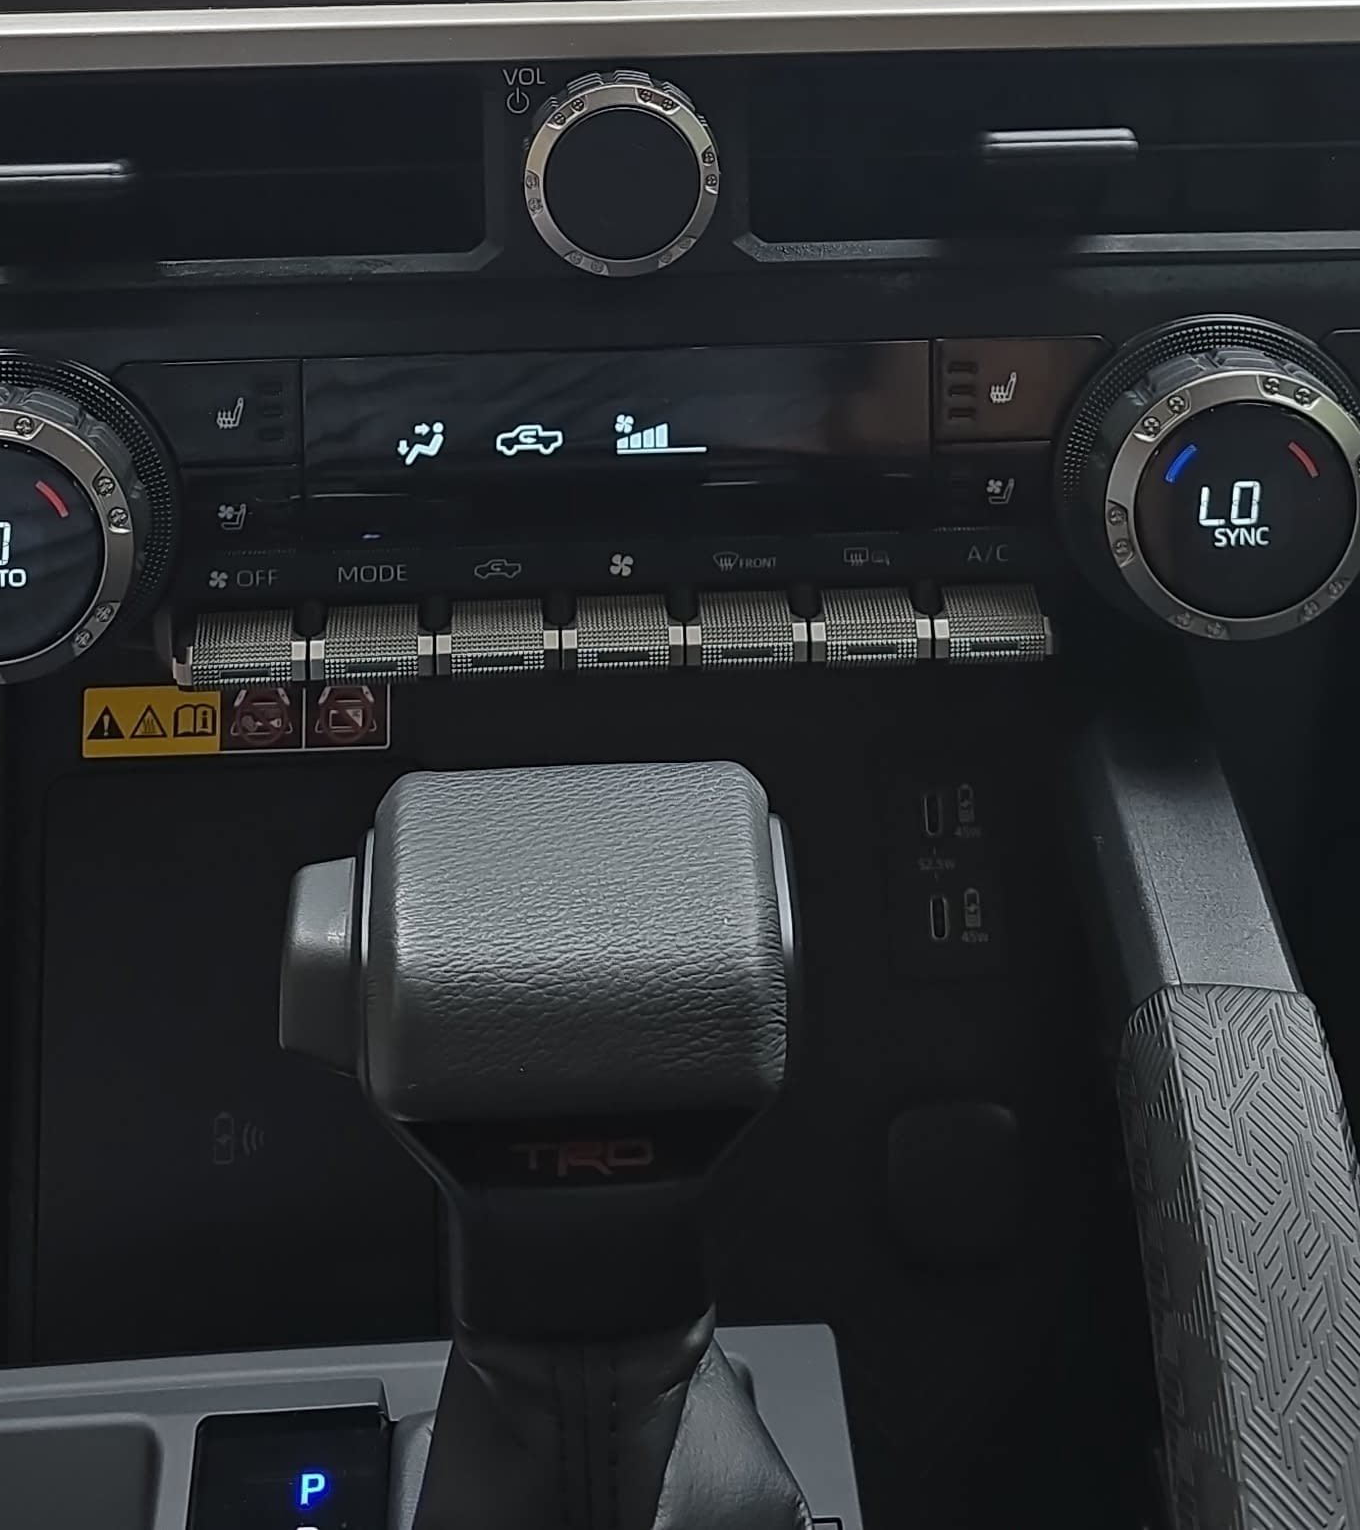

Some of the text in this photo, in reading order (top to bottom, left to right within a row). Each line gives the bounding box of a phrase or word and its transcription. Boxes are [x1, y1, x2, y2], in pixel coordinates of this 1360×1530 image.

[502, 67, 547, 86] VOL
[1213, 525, 1272, 548] SYNC
[738, 555, 778, 569] FRONT
[967, 543, 1010, 564] A/C
[235, 569, 281, 589] OFF
[337, 563, 409, 584] MODE
[508, 1137, 657, 1179] TRD
[300, 1472, 326, 1506] P
